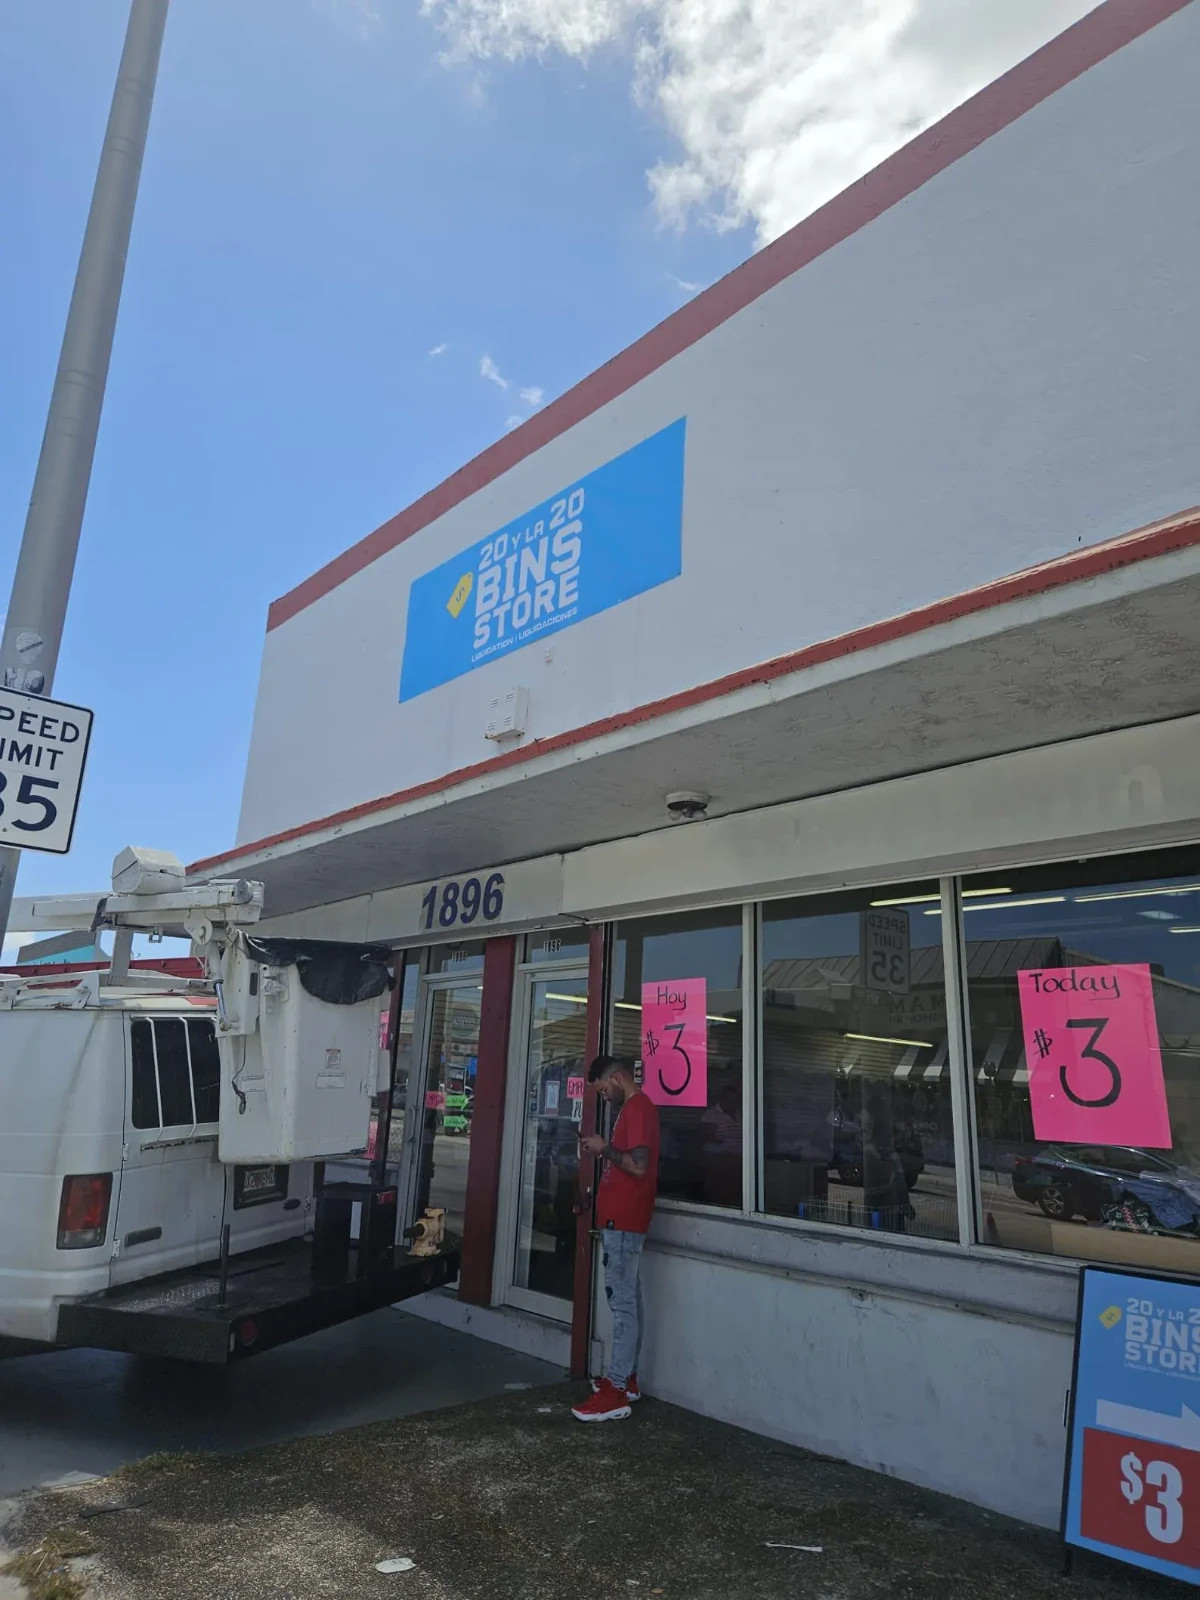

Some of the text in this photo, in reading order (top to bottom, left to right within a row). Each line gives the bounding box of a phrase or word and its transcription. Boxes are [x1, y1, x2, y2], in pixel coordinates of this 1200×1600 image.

[479, 487, 585, 570] 20 Y LA 20
[475, 519, 582, 617] BINS
[473, 565, 580, 650] STORE
[471, 636, 514, 662] LIQUIDATION
[0, 706, 80, 743] PEED
[0, 738, 64, 771] IMIT
[422, 872, 505, 930] 1896
[657, 986, 687, 1010] Hoy
[1029, 968, 1121, 1001] Today
[1126, 1298, 1153, 1316] 20
[1188, 1307, 1200, 1325] 2
[1125, 1341, 1200, 1375] STOR
[1120, 1451, 1183, 1544] $3
